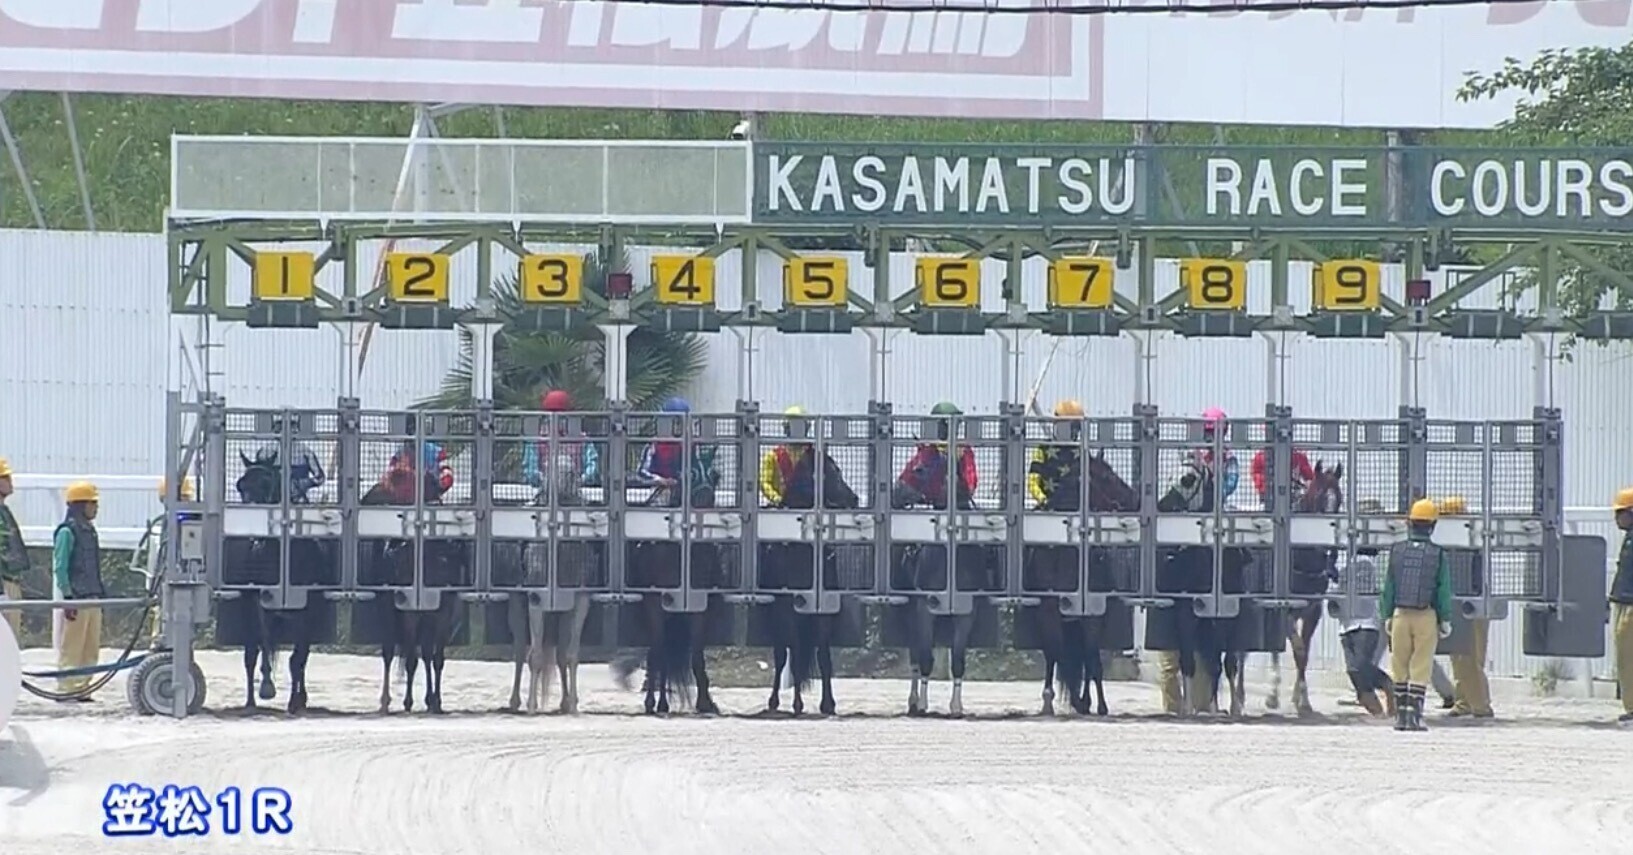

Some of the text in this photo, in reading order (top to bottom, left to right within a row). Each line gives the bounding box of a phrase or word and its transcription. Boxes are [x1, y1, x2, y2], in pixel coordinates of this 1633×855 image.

[767, 154, 1633, 217] KASAMATSU RACE COURS
[281, 257, 289, 293] 1
[403, 256, 436, 296] 2
[537, 260, 569, 297] 3
[669, 260, 701, 299] 4
[803, 262, 835, 299] 5
[935, 263, 969, 300] 6
[1069, 264, 1101, 302] 7
[1201, 266, 1234, 303] 8
[1336, 266, 1368, 303] 9
